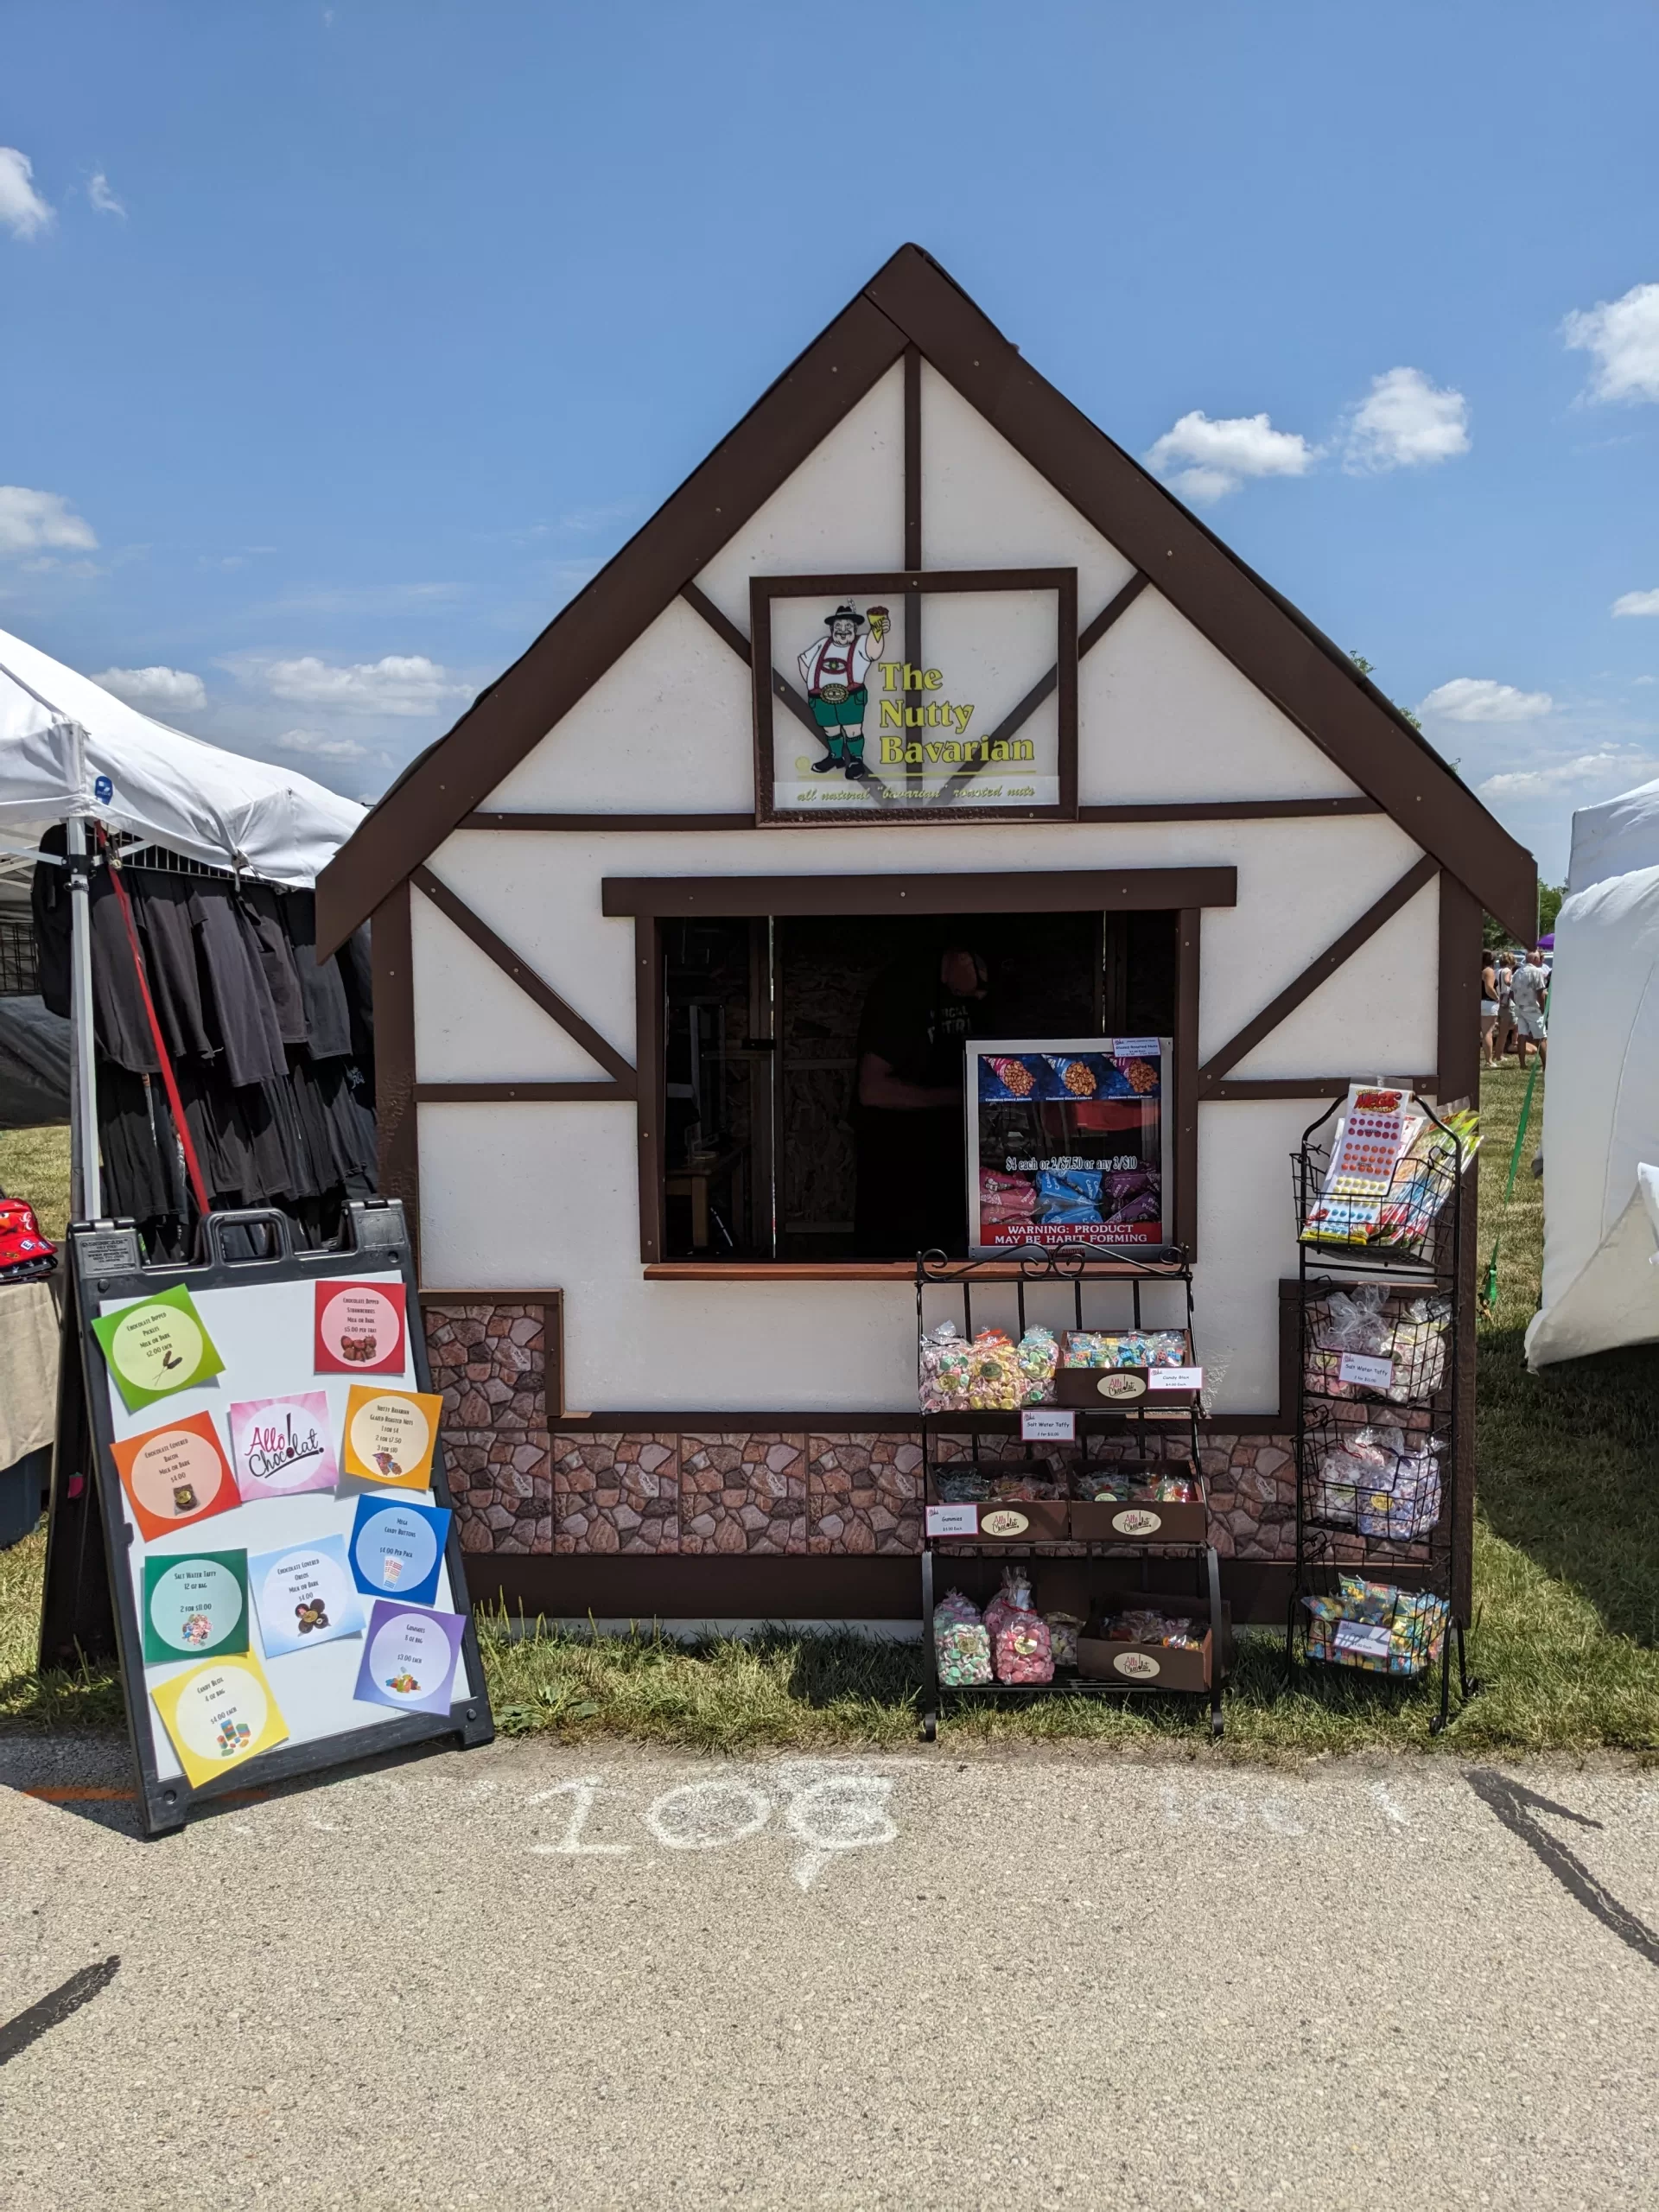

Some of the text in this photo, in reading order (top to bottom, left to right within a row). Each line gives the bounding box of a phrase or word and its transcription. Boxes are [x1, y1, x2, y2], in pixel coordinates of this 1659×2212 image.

[879, 663, 943, 691] The
[880, 700, 974, 734] Nutty
[880, 735, 1034, 764] Bavarian
[797, 789, 817, 802] all
[821, 788, 870, 800] natural
[953, 785, 1001, 797] roasted
[1007, 786, 1035, 797] nuts
[1006, 1156, 1017, 1171] $4
[1019, 1157, 1038, 1170] each
[1039, 1160, 1050, 1170] or
[1084, 1160, 1095, 1170] or
[1096, 1160, 1112, 1172] any
[1113, 1155, 1137, 1170] 3/$10
[1007, 1224, 1134, 1234] WARNING: PRODUCT
[995, 1236, 1023, 1244] MAY
[1046, 1235, 1084, 1243] HABIT
[1090, 1234, 1147, 1243] FORMING
[170, 1472, 186, 1483] $4.00
[299, 1592, 313, 1602] $4.00
